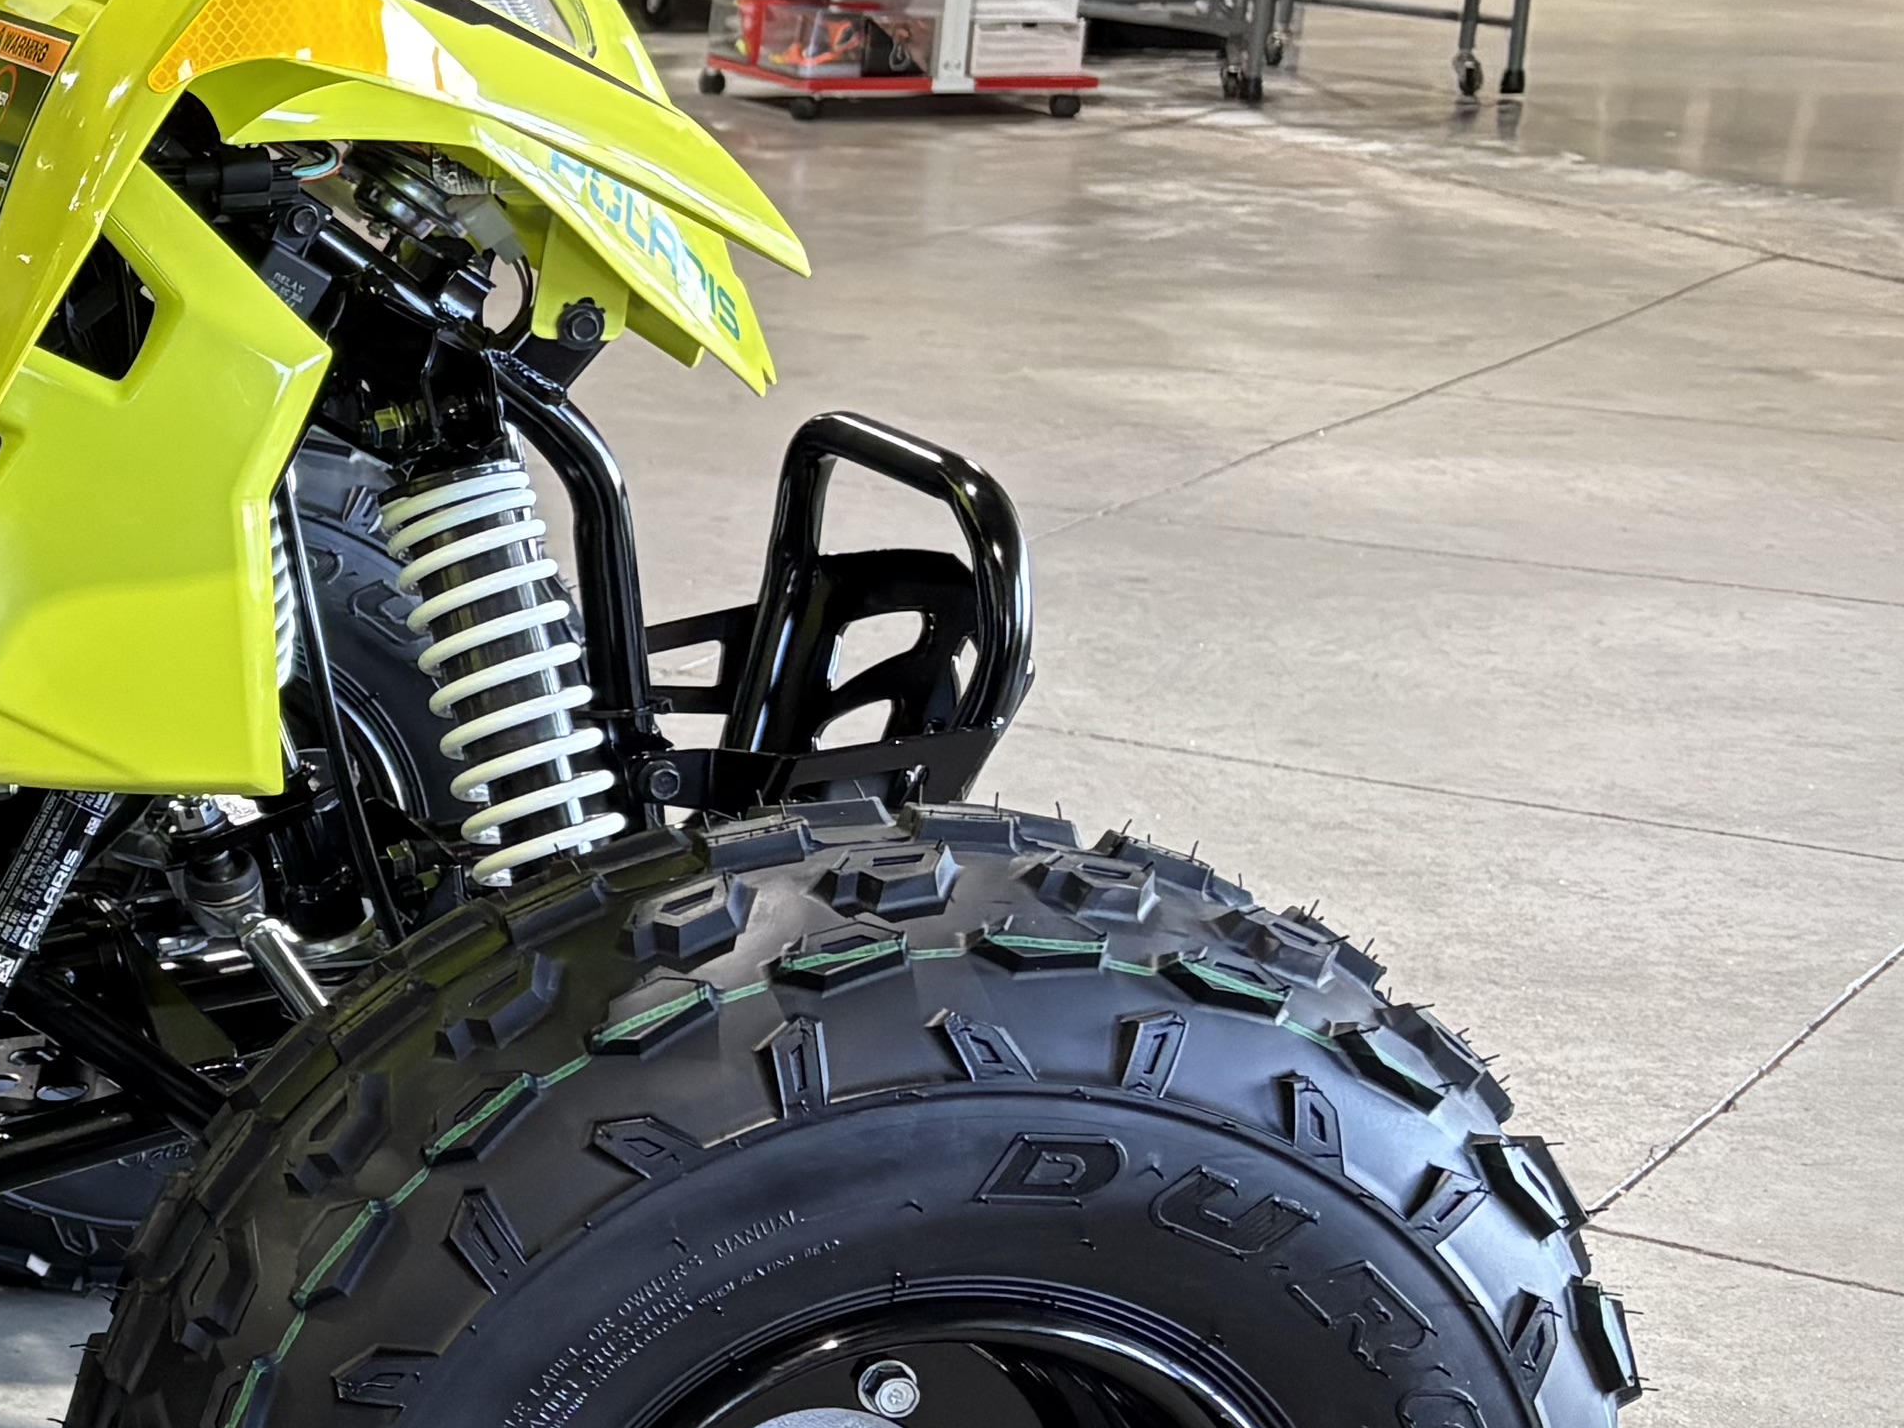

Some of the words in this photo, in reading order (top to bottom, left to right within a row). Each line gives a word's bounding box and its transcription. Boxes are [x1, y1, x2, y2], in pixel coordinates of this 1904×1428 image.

[3, 31, 49, 62] WARNING
[3, 850, 28, 889] CONTROL
[17, 846, 80, 951] POLARIS
[529, 1344, 587, 1399] LABEL
[588, 1316, 615, 1342] OR
[582, 1286, 689, 1374] PRESSURE
